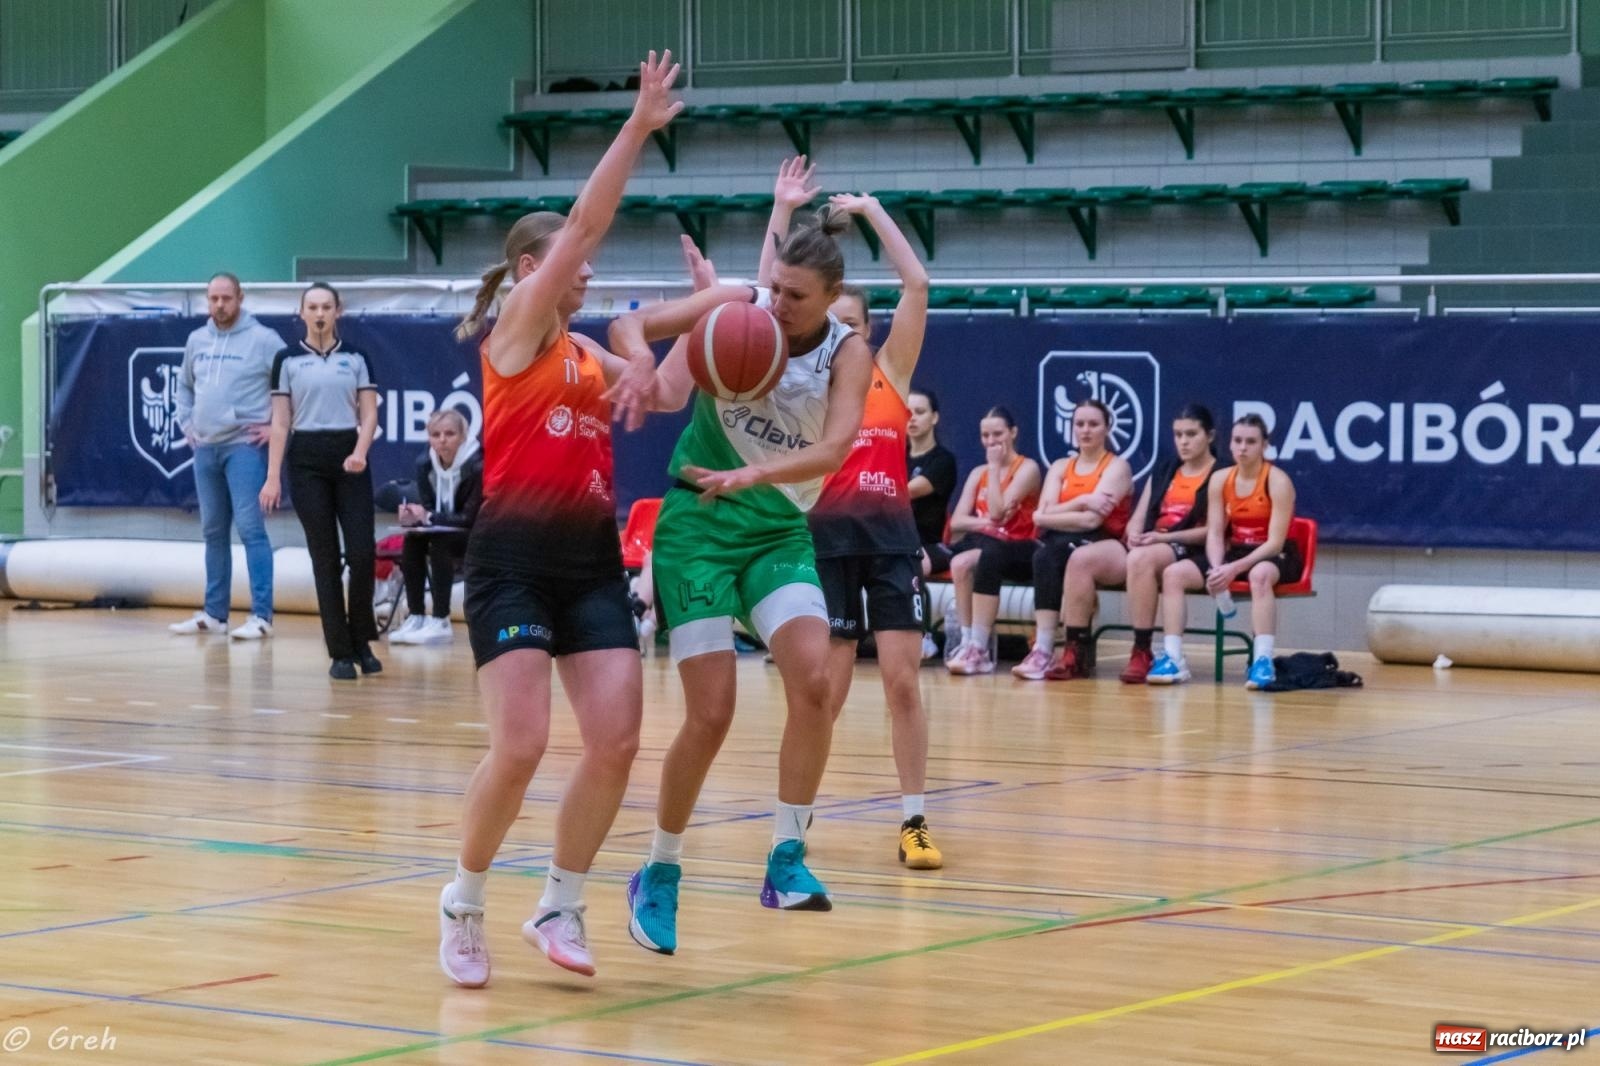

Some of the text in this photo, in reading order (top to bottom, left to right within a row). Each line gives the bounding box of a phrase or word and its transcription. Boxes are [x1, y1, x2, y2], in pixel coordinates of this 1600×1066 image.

[853, 438, 872, 448] ska
[859, 471, 886, 484] EMT
[678, 580, 715, 612] 14
[913, 594, 923, 621] 8
